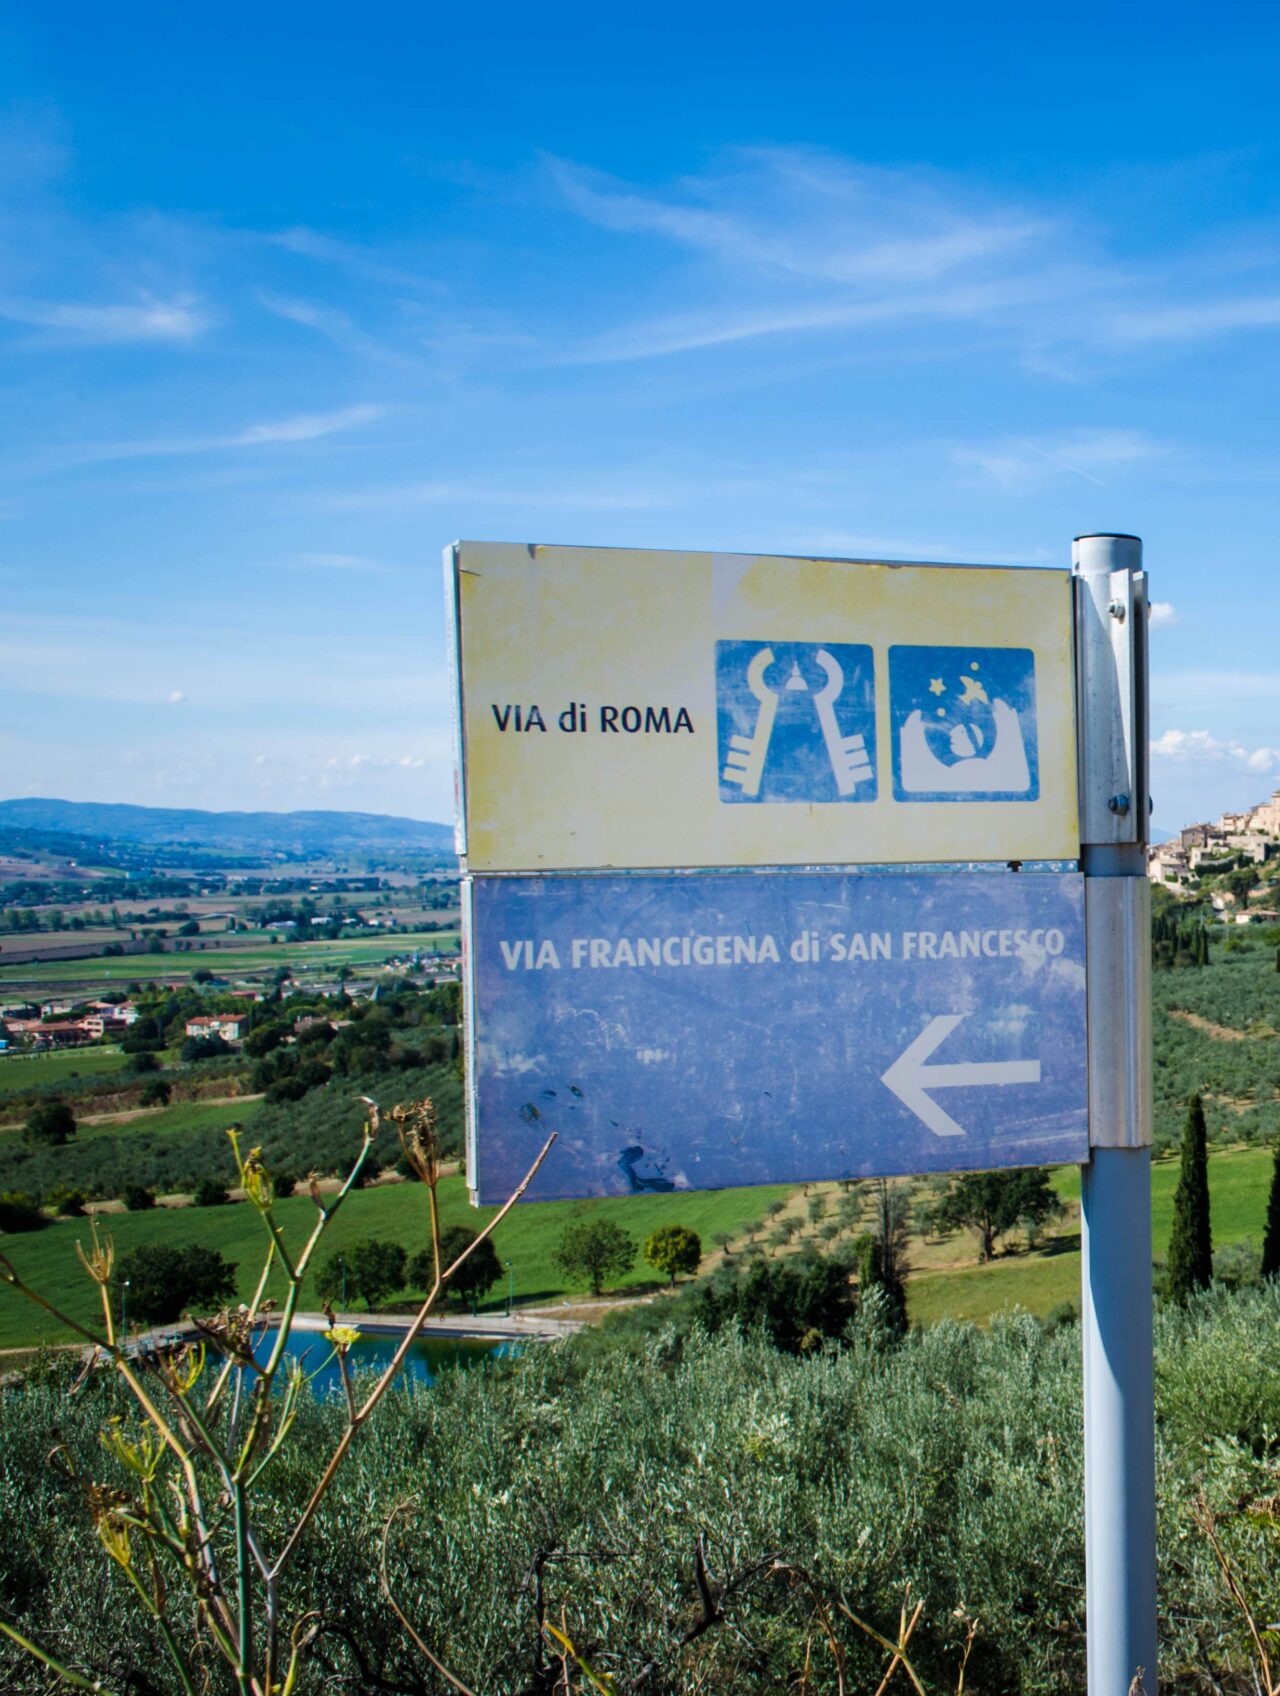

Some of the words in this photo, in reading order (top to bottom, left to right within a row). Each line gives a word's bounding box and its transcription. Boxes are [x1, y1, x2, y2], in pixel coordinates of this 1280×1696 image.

[491, 704, 547, 732] VIA
[558, 702, 587, 732] di
[600, 706, 695, 733] ROMA
[500, 940, 561, 970] VIA
[571, 935, 780, 968] FRANCIGENA
[790, 930, 819, 962] di
[830, 932, 892, 961] SAN
[903, 928, 1064, 960] FRANCESCO
